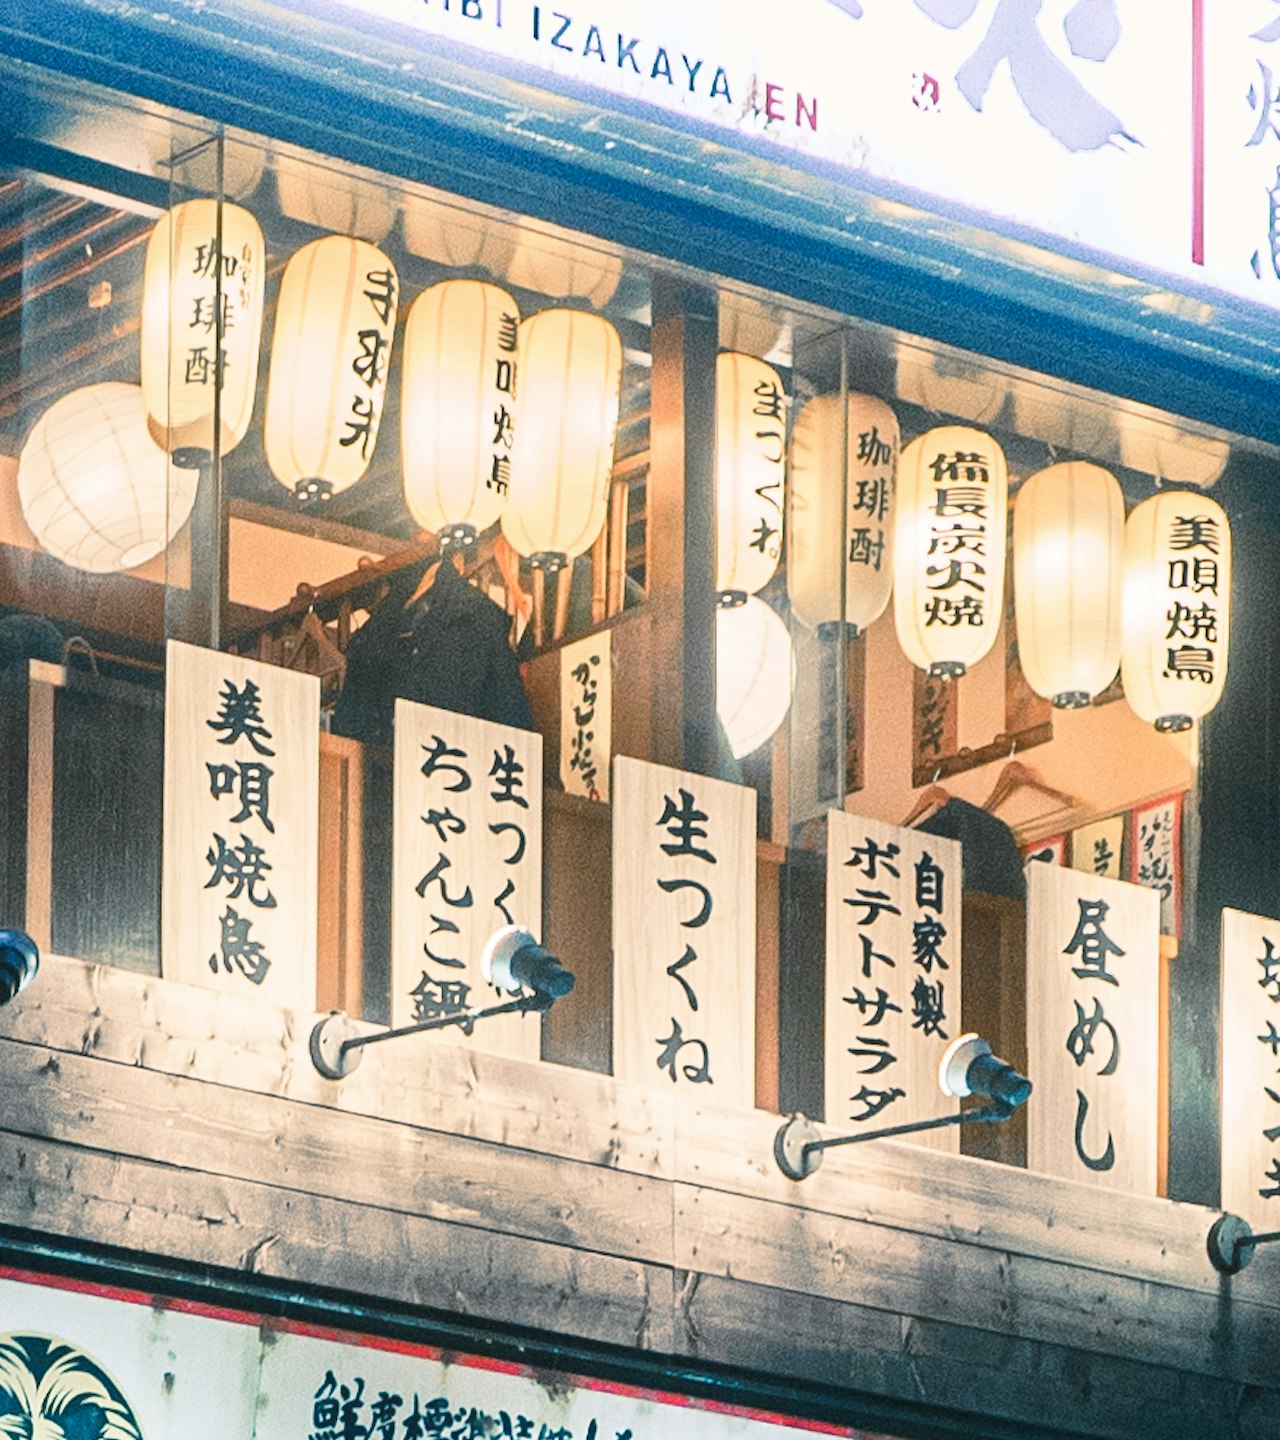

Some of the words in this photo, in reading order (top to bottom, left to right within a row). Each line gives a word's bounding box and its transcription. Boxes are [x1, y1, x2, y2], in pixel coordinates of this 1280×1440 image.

[531, 5, 732, 98] IZAKAYA
[767, 83, 819, 132] EN
[925, 450, 990, 630] 備長炭火焼
[1163, 515, 1221, 686] 美唄焼鳥
[204, 679, 278, 985] 美唄焼鳥
[409, 735, 473, 1035] ちゃんこ鍋
[655, 787, 718, 1085] 生つくね
[910, 850, 949, 1040] 自家製
[844, 837, 905, 1123] ポテトサラダ
[1062, 897, 1126, 1170] 昼めし
